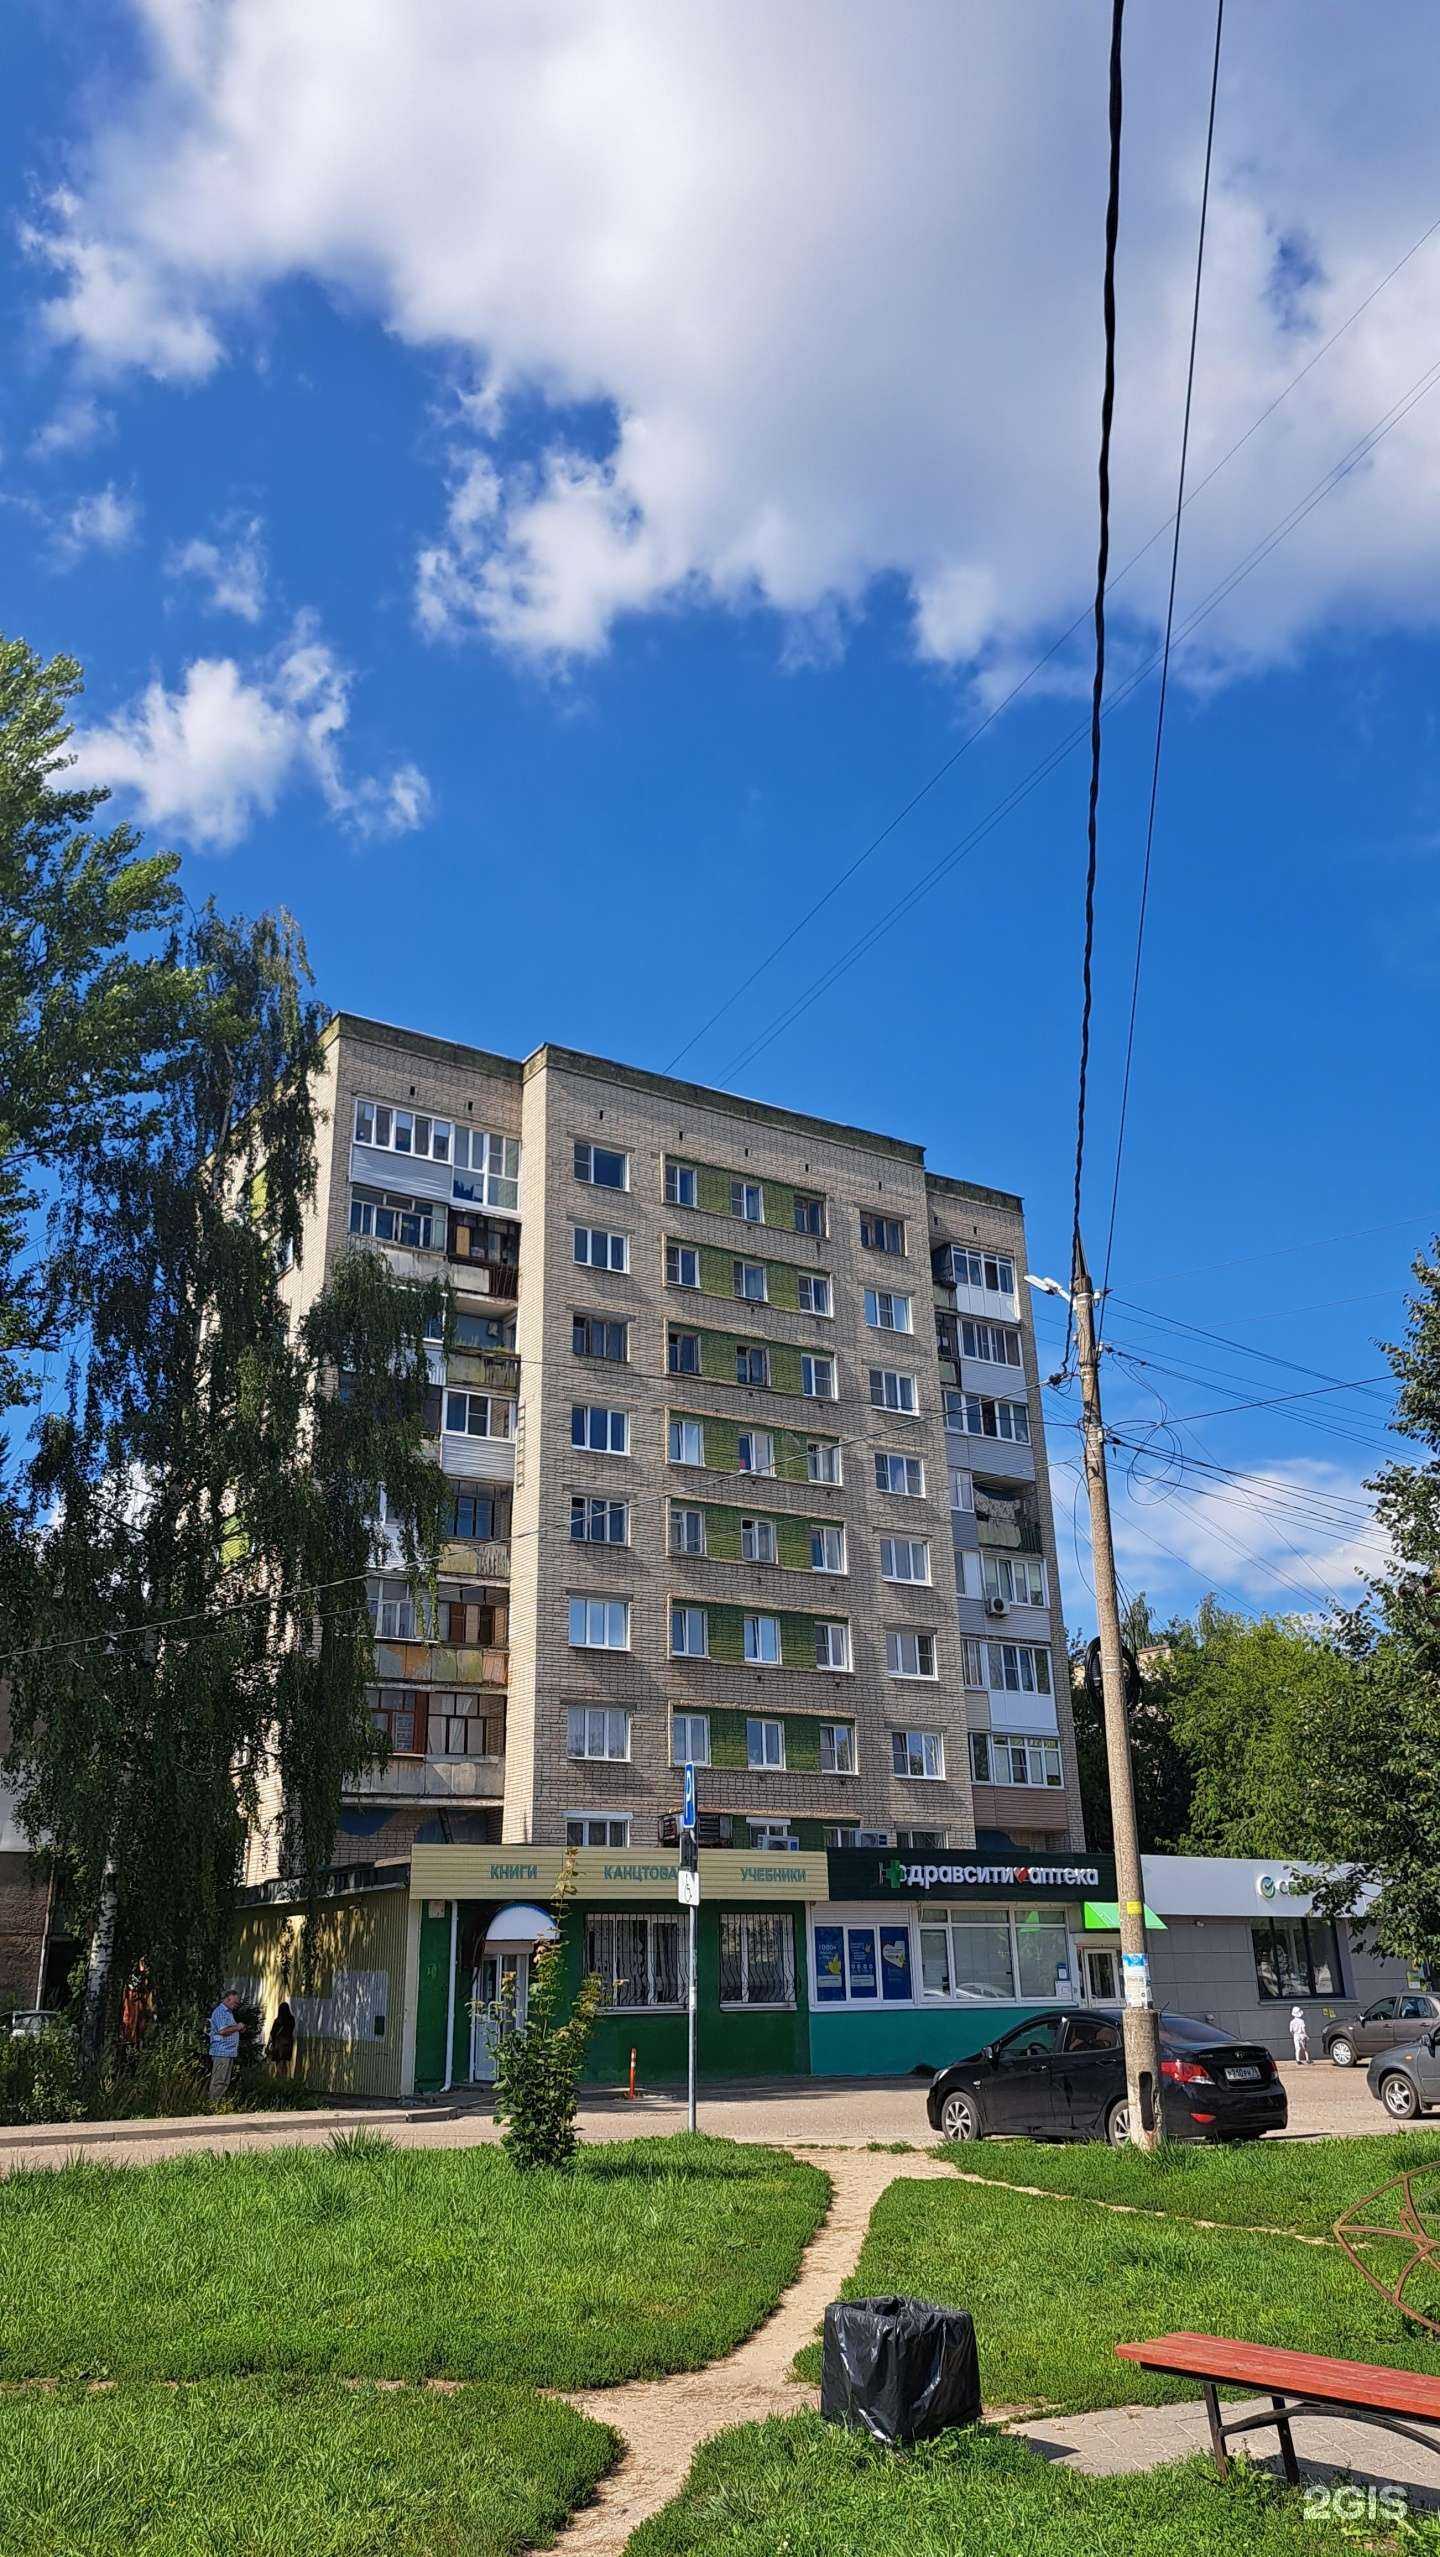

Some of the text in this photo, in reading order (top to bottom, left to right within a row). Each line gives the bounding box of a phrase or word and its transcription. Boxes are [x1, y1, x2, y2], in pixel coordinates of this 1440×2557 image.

[490, 1864, 538, 1880] КНИГИ
[604, 1865, 680, 1882] КАНЦТОВА
[740, 1867, 807, 1882] УЧЕБНИКИ
[1028, 1867, 1099, 1885] аптека
